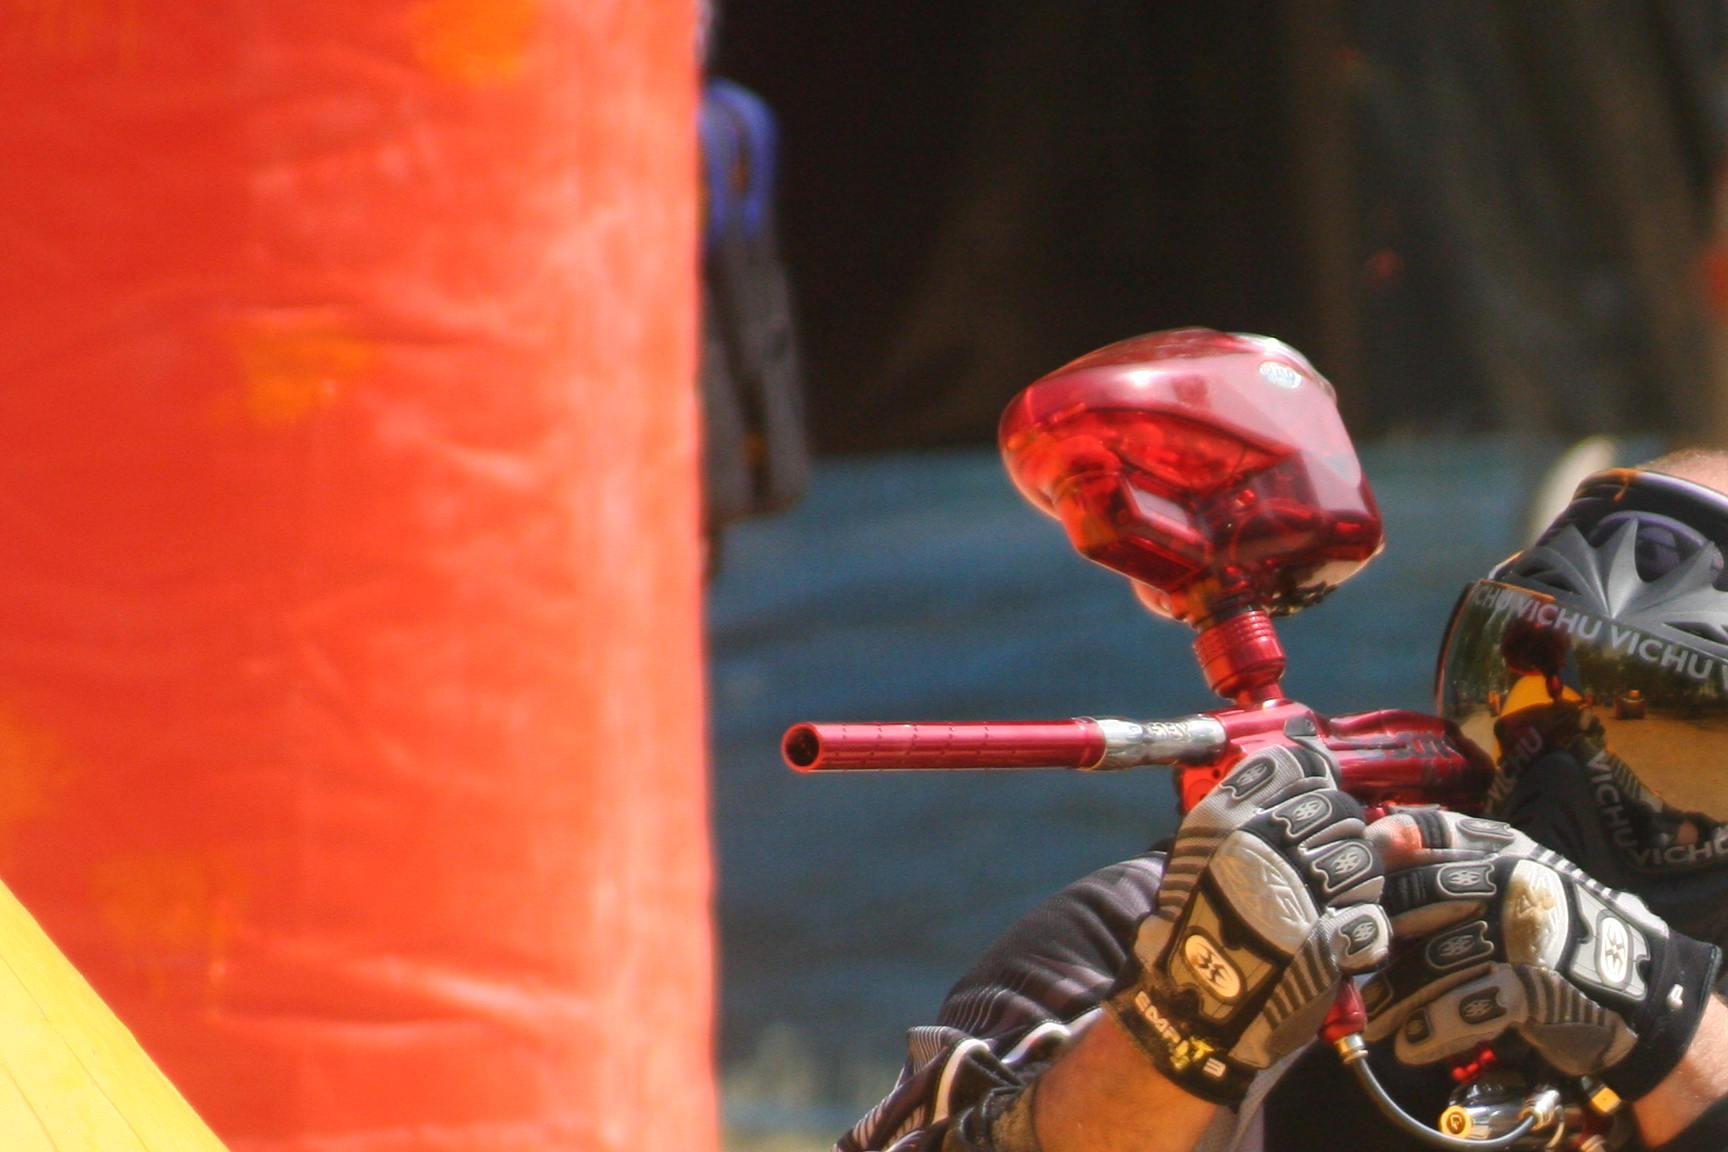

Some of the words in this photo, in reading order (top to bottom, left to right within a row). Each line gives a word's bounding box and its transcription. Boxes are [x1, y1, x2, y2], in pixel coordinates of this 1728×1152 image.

[1517, 597, 1602, 640] VICHU
[1610, 625, 1713, 681] VICHU
[1587, 750, 1639, 848] VICHU
